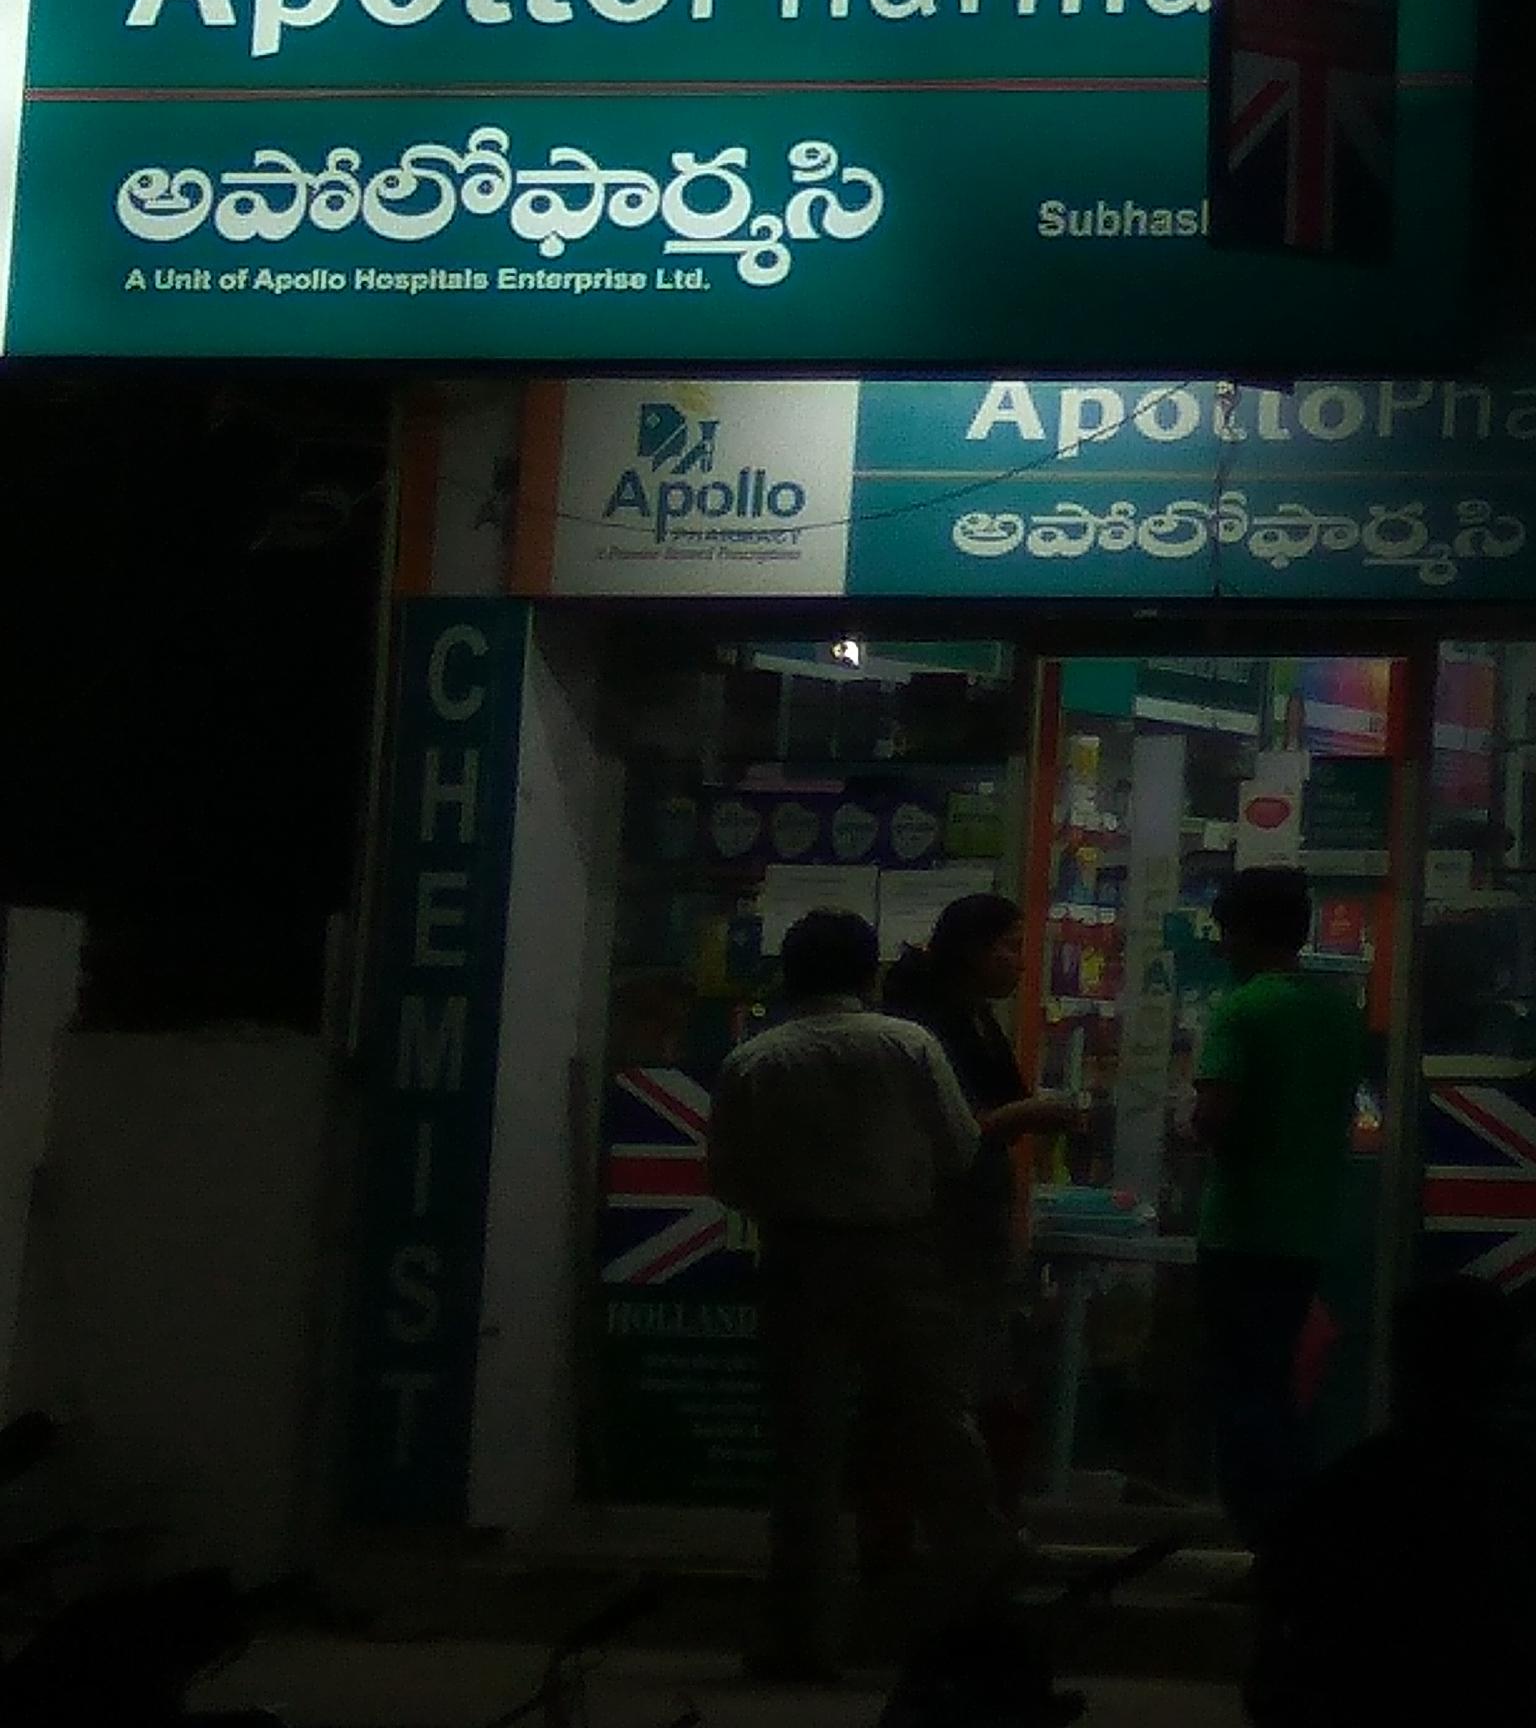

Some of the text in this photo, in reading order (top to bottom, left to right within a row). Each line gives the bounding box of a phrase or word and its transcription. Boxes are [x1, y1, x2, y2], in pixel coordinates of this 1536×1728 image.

[124, 268, 713, 295] A Unit of Apollo Hospitals Enterprise Ltd.
[601, 466, 807, 544] Apollo
[379, 623, 491, 1471] CHEMIST
